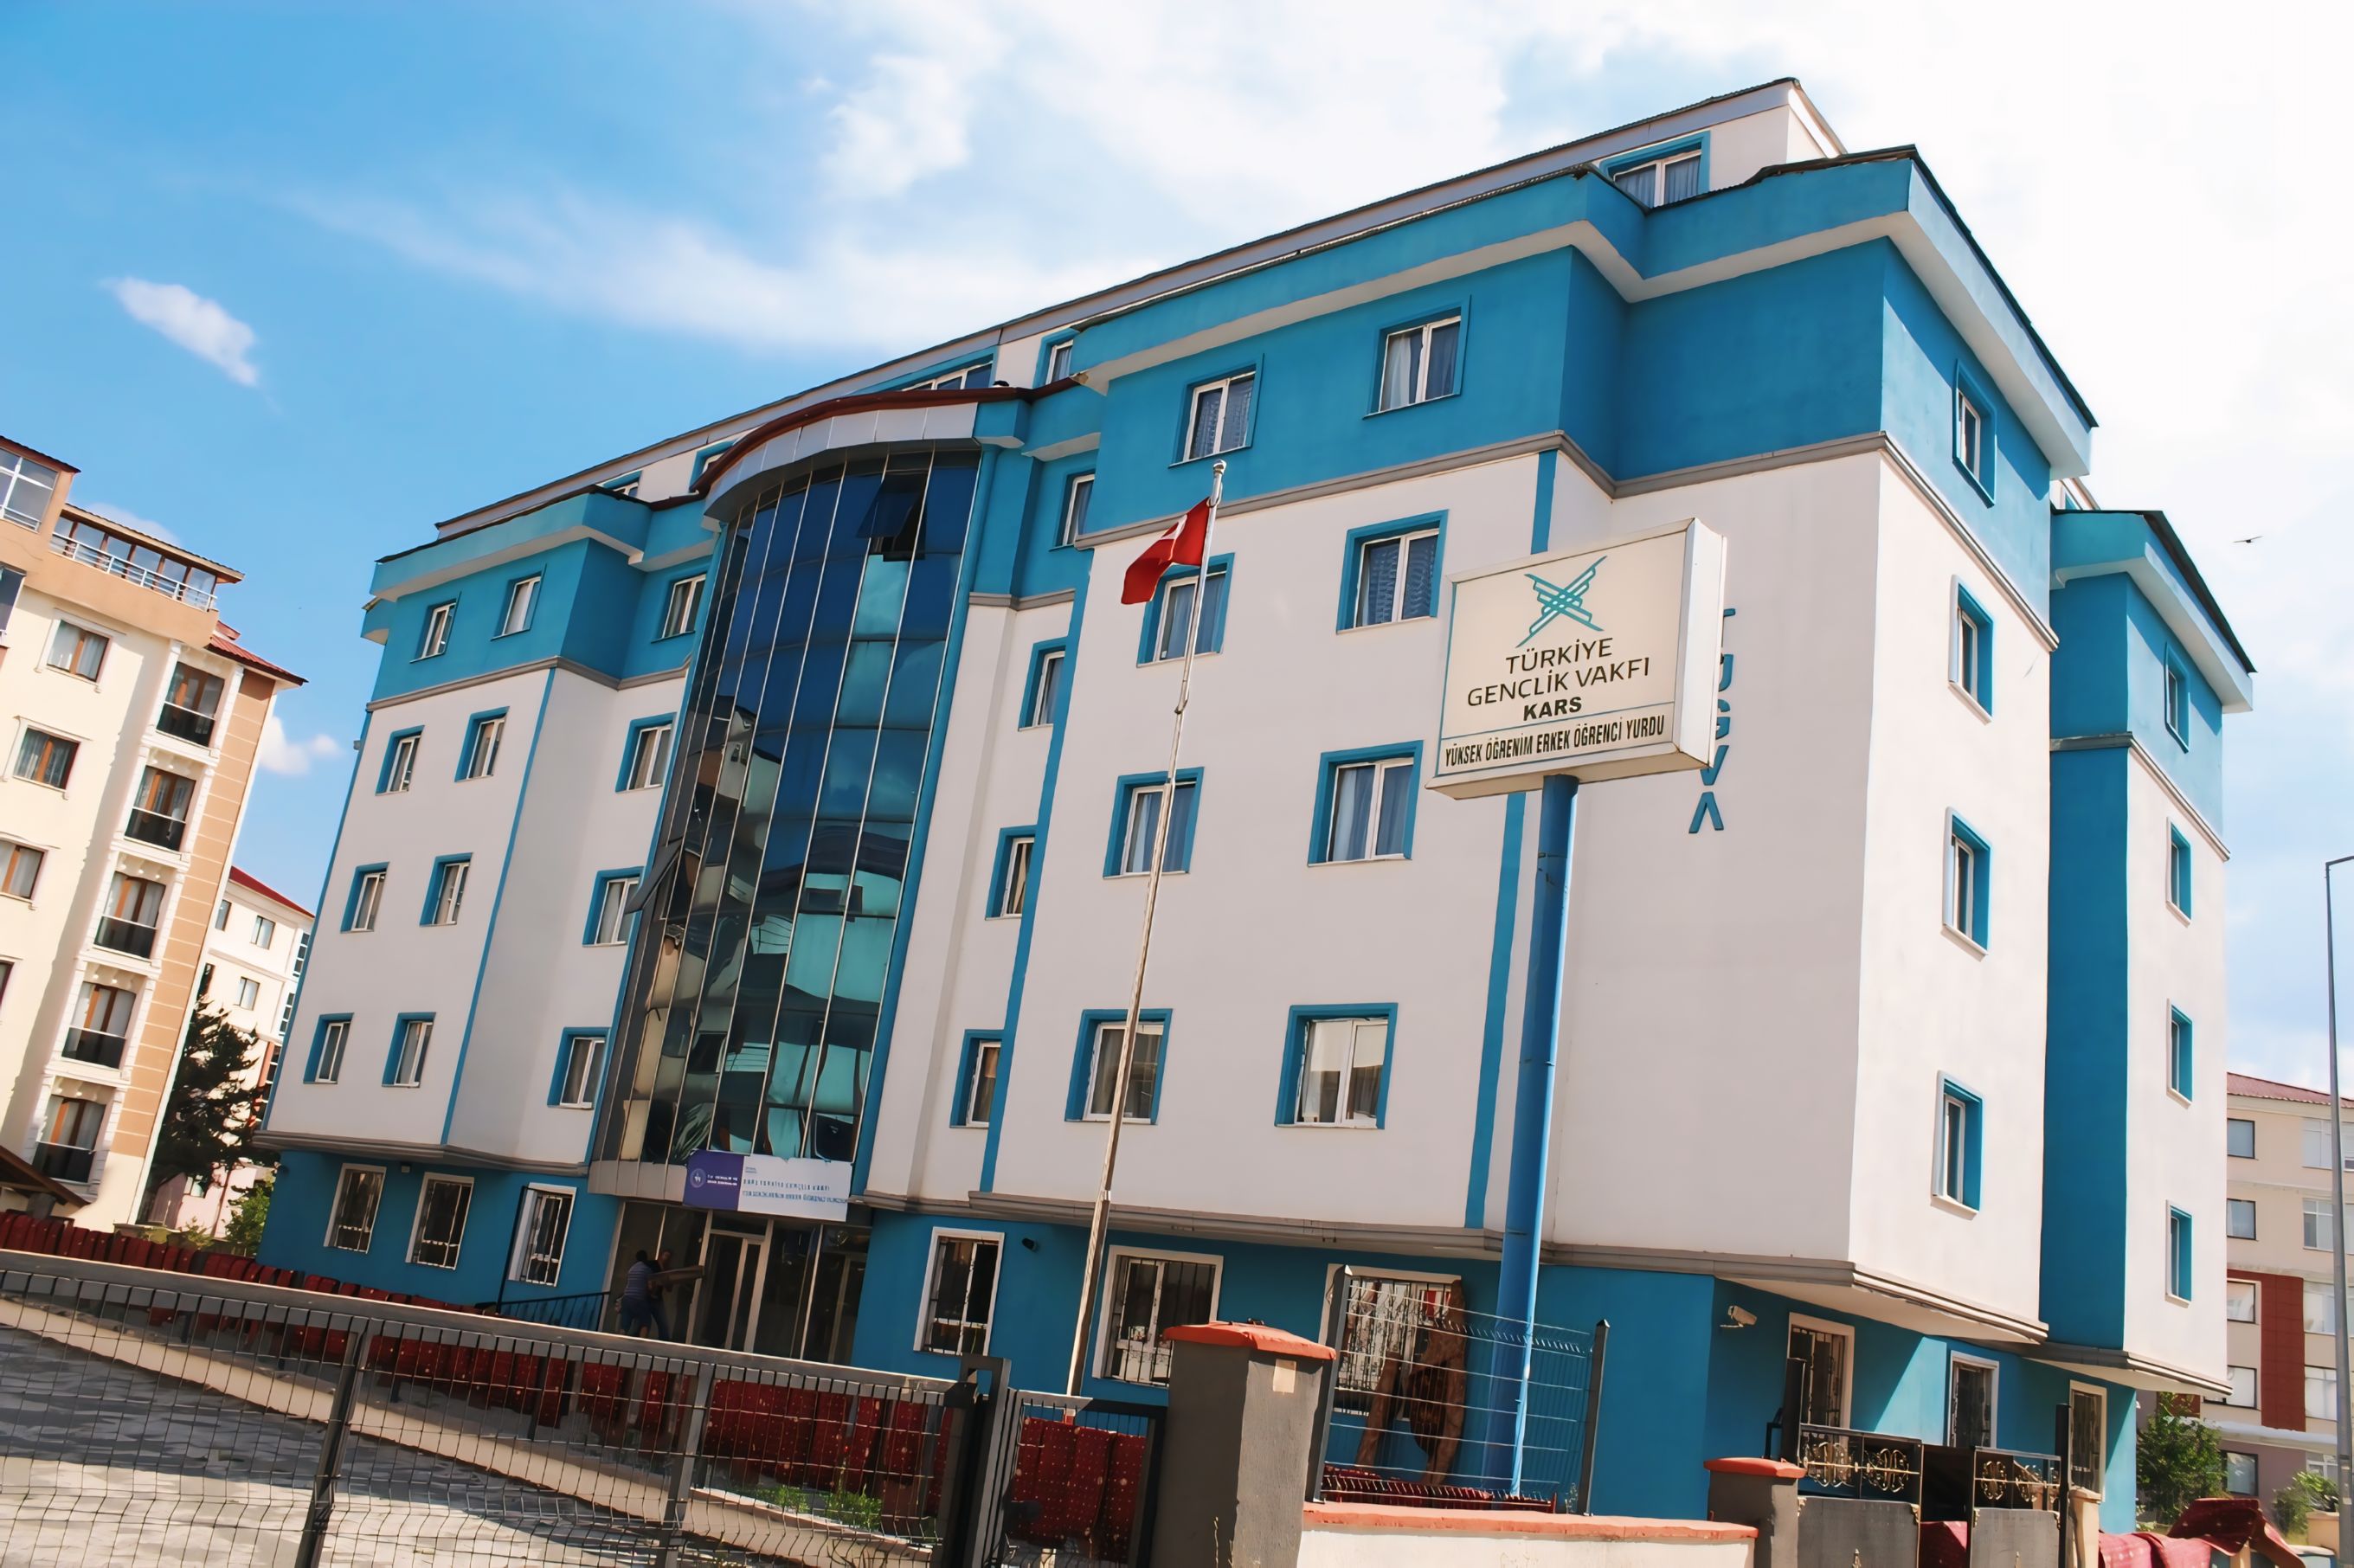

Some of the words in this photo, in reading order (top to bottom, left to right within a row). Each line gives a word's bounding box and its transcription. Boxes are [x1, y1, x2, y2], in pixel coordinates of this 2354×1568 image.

[1506, 638, 1613, 674] TÜRKİYE
[1468, 669, 1569, 706] GENÇLİK
[1576, 657, 1650, 687] VAKFI
[1523, 697, 1582, 721] KARS
[1445, 743, 1483, 767] YÜKSEK
[1486, 733, 1533, 761] ÖĞRENİM
[1536, 729, 1570, 751] ERKEK
[1573, 717, 1623, 747] ÖĞRENCİ
[1626, 715, 1664, 739] YURDU
